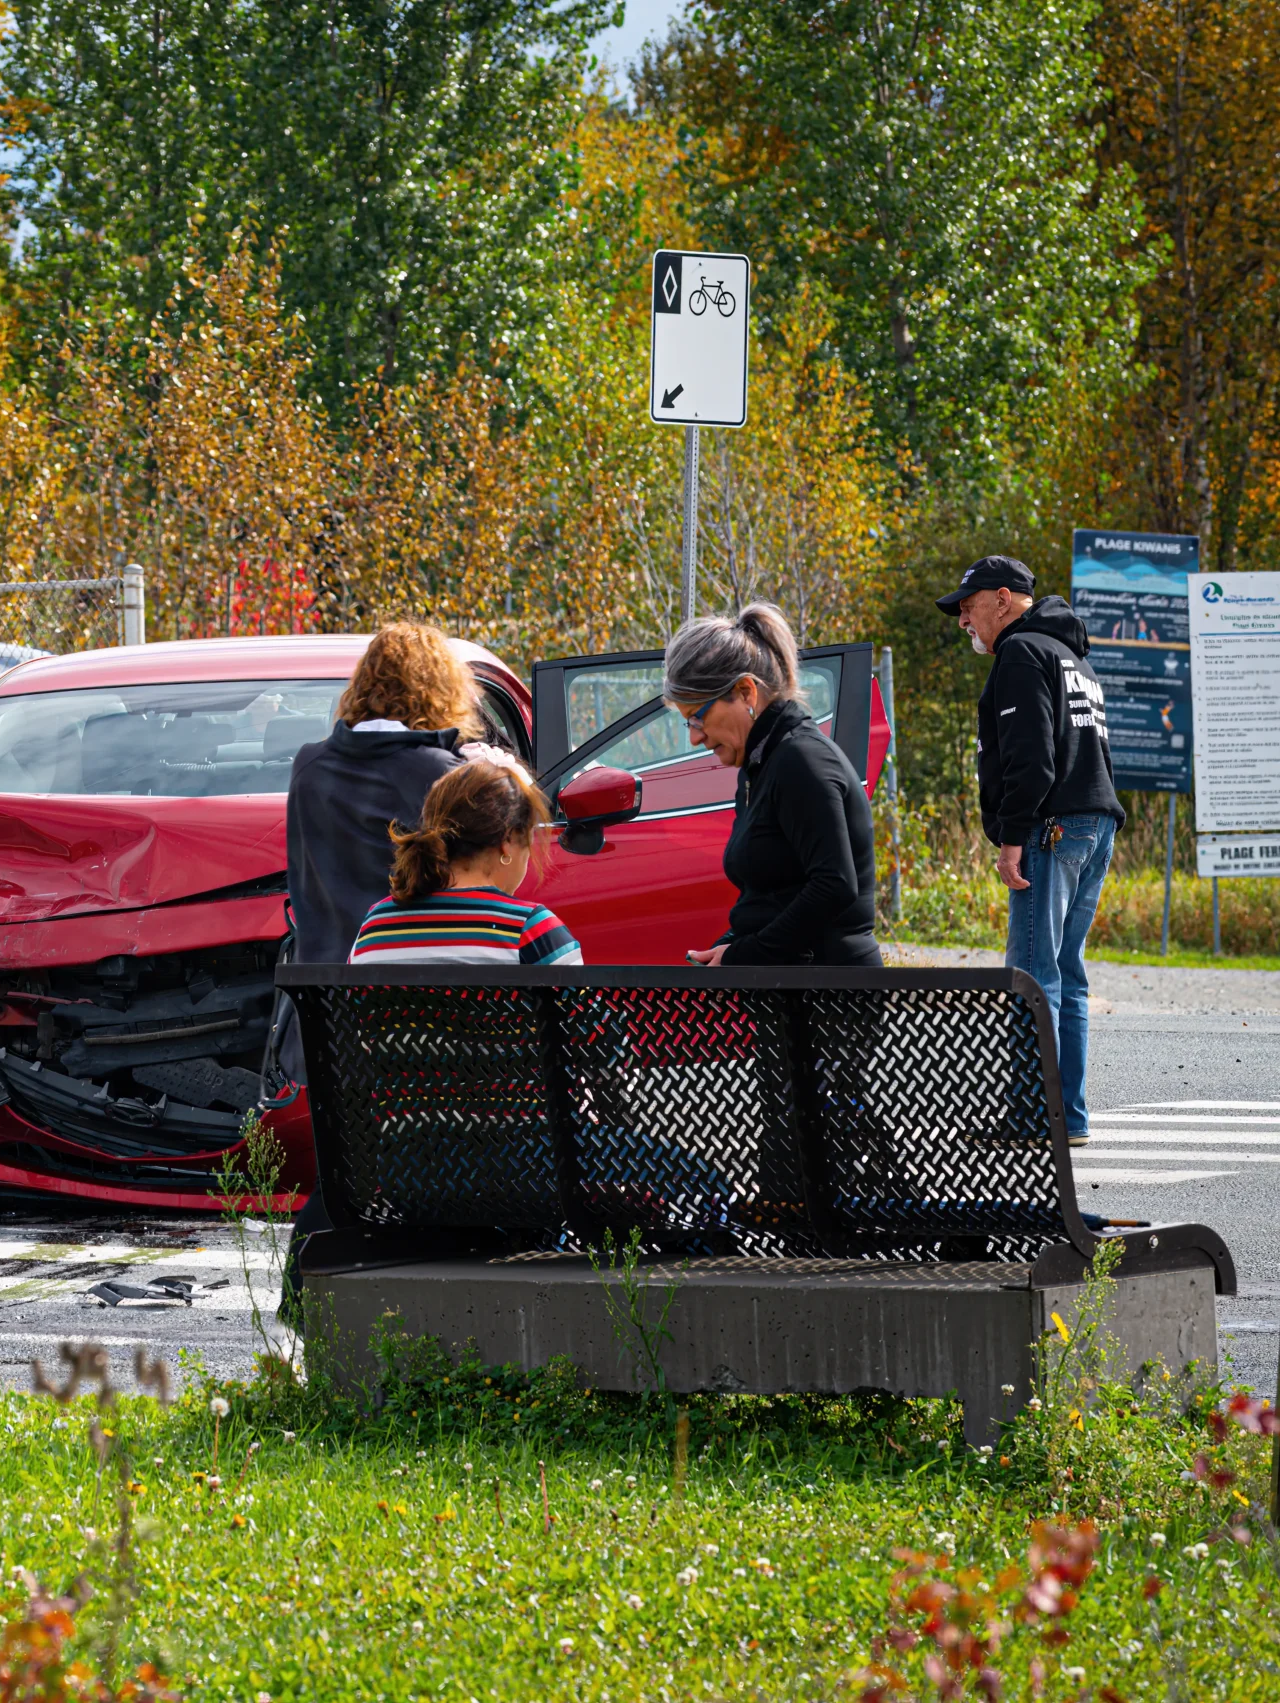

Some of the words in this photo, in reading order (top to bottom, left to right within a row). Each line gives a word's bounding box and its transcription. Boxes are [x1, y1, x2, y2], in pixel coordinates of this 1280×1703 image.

[1094, 537, 1131, 551] PLAGE
[1133, 541, 1182, 555] KIWANIS
[1220, 846, 1255, 860] PLAGE
